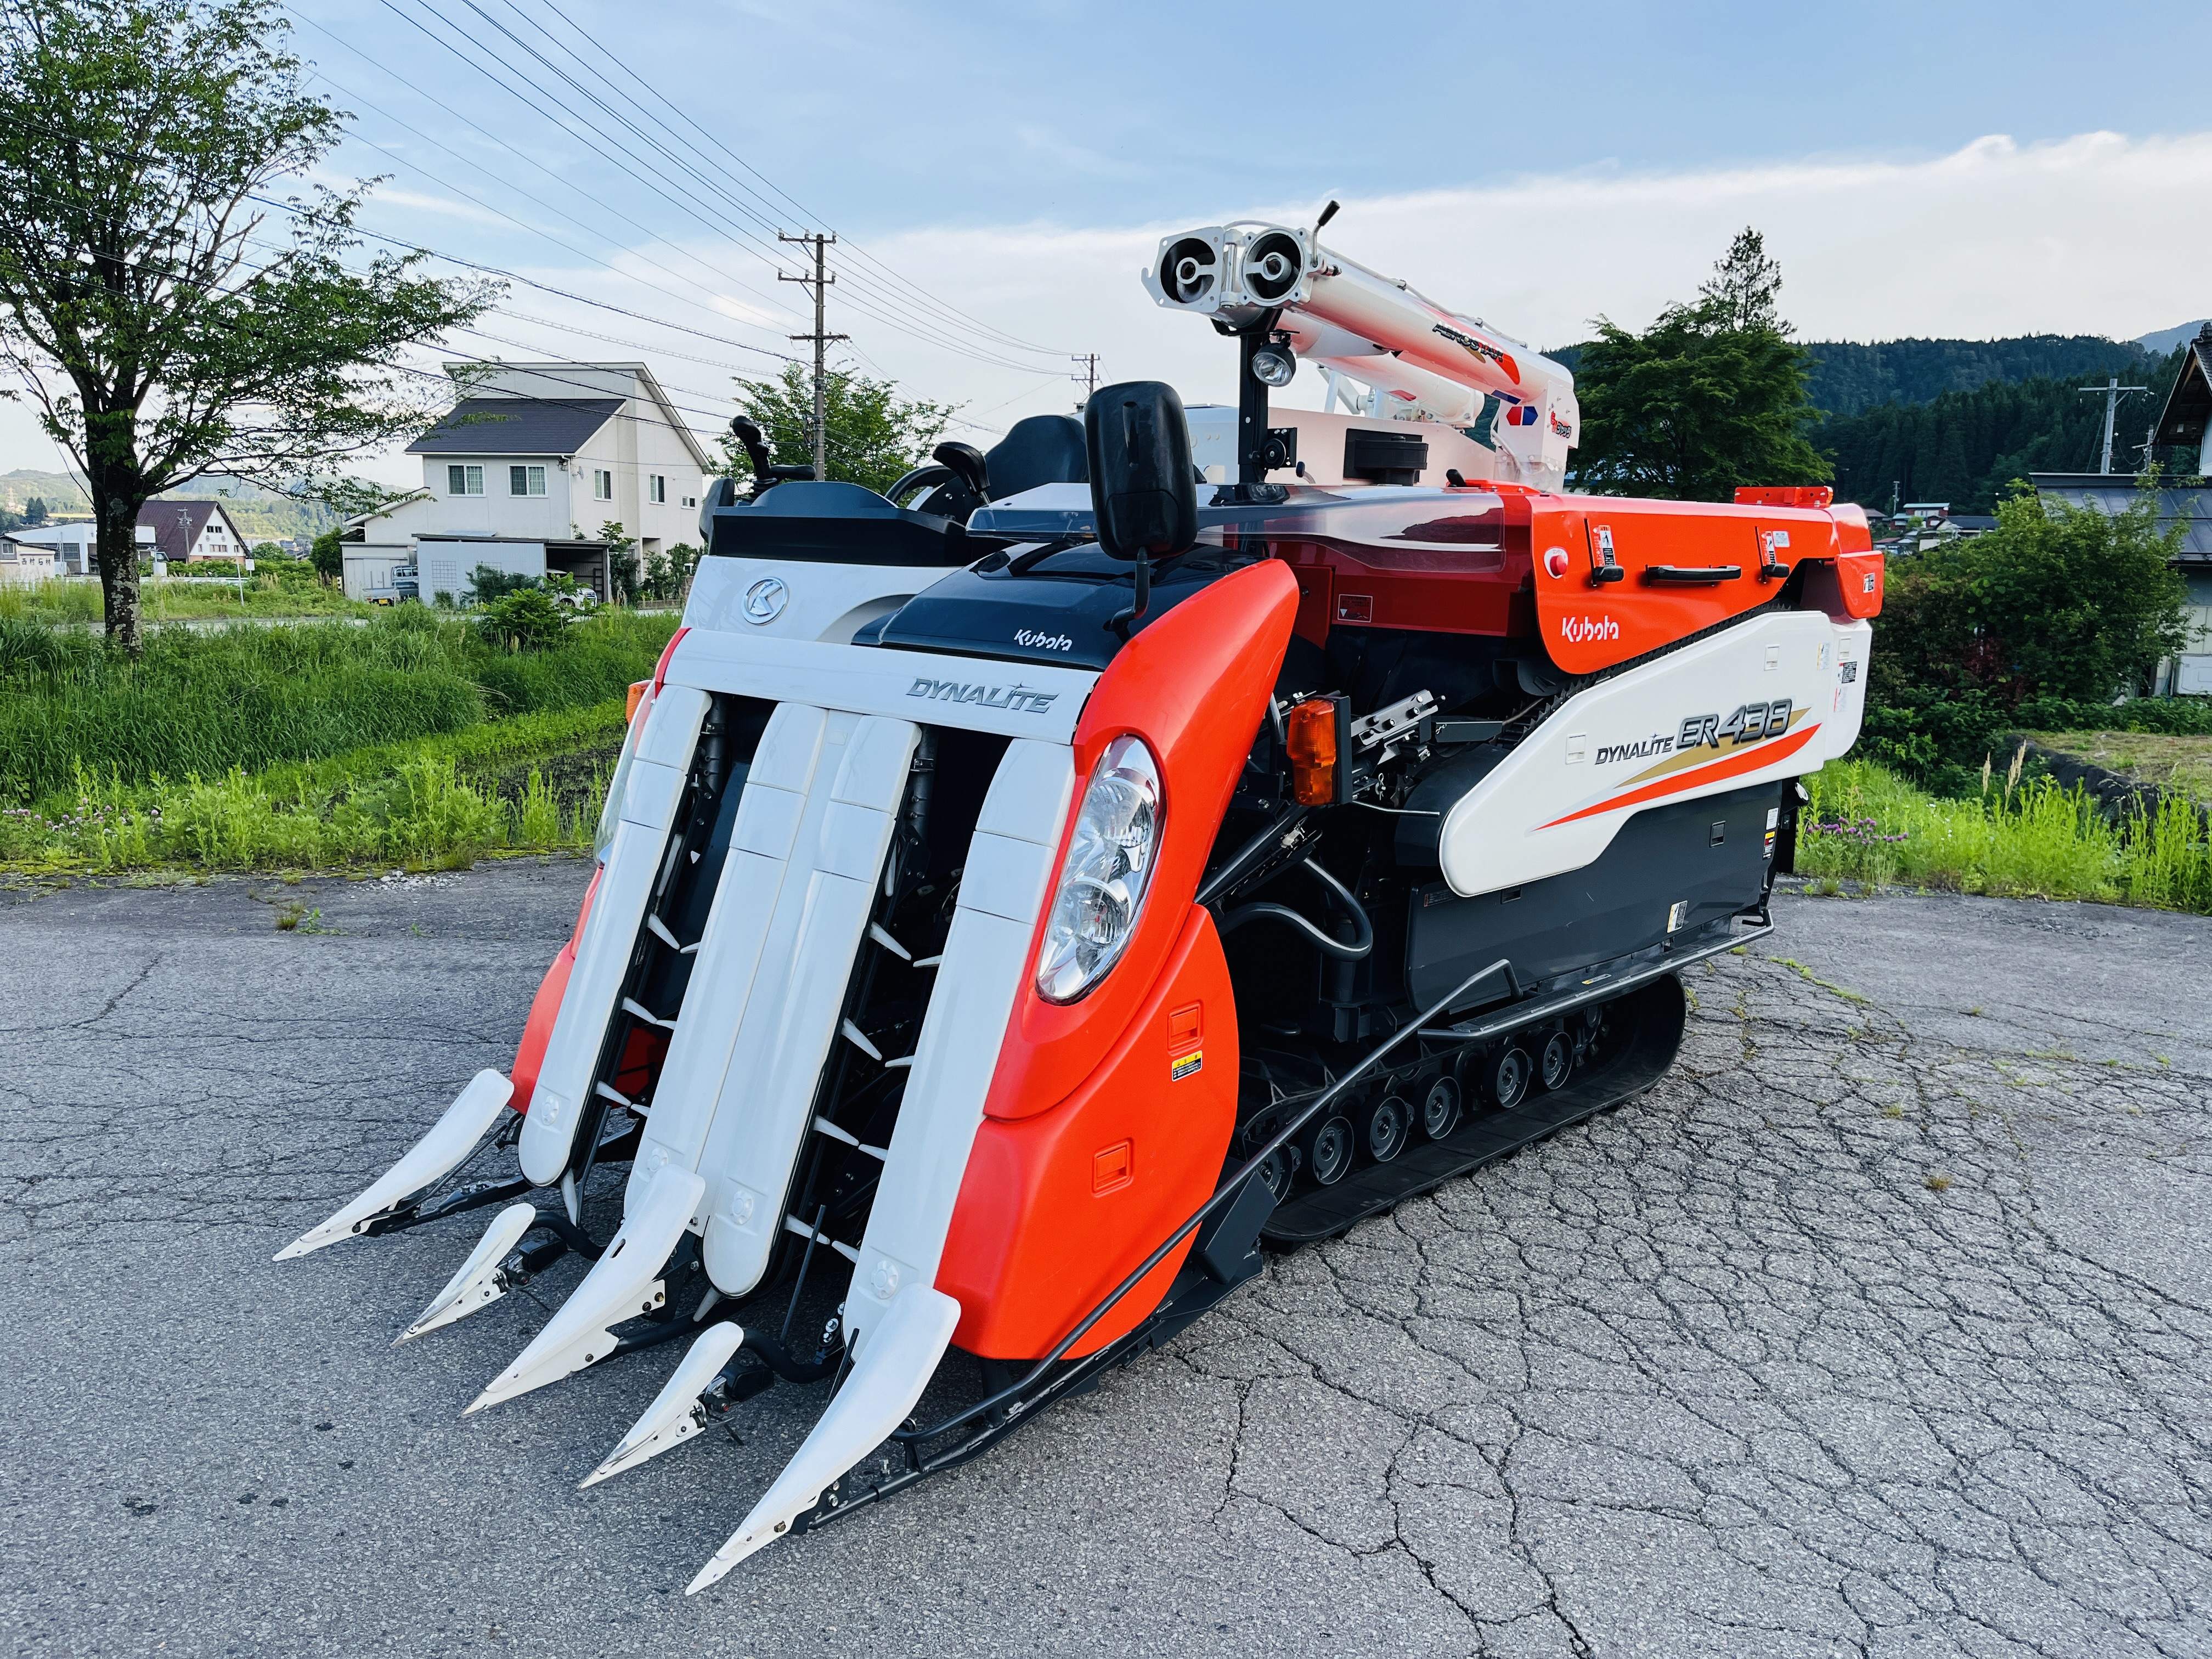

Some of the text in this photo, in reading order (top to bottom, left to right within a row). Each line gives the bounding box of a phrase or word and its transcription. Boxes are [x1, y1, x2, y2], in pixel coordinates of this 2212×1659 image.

[1432, 320, 1504, 363] AEROSTAR
[21, 557, 51, 566] 西村石材
[1013, 629, 1073, 651] Kubota
[1561, 615, 1619, 642] Kubota
